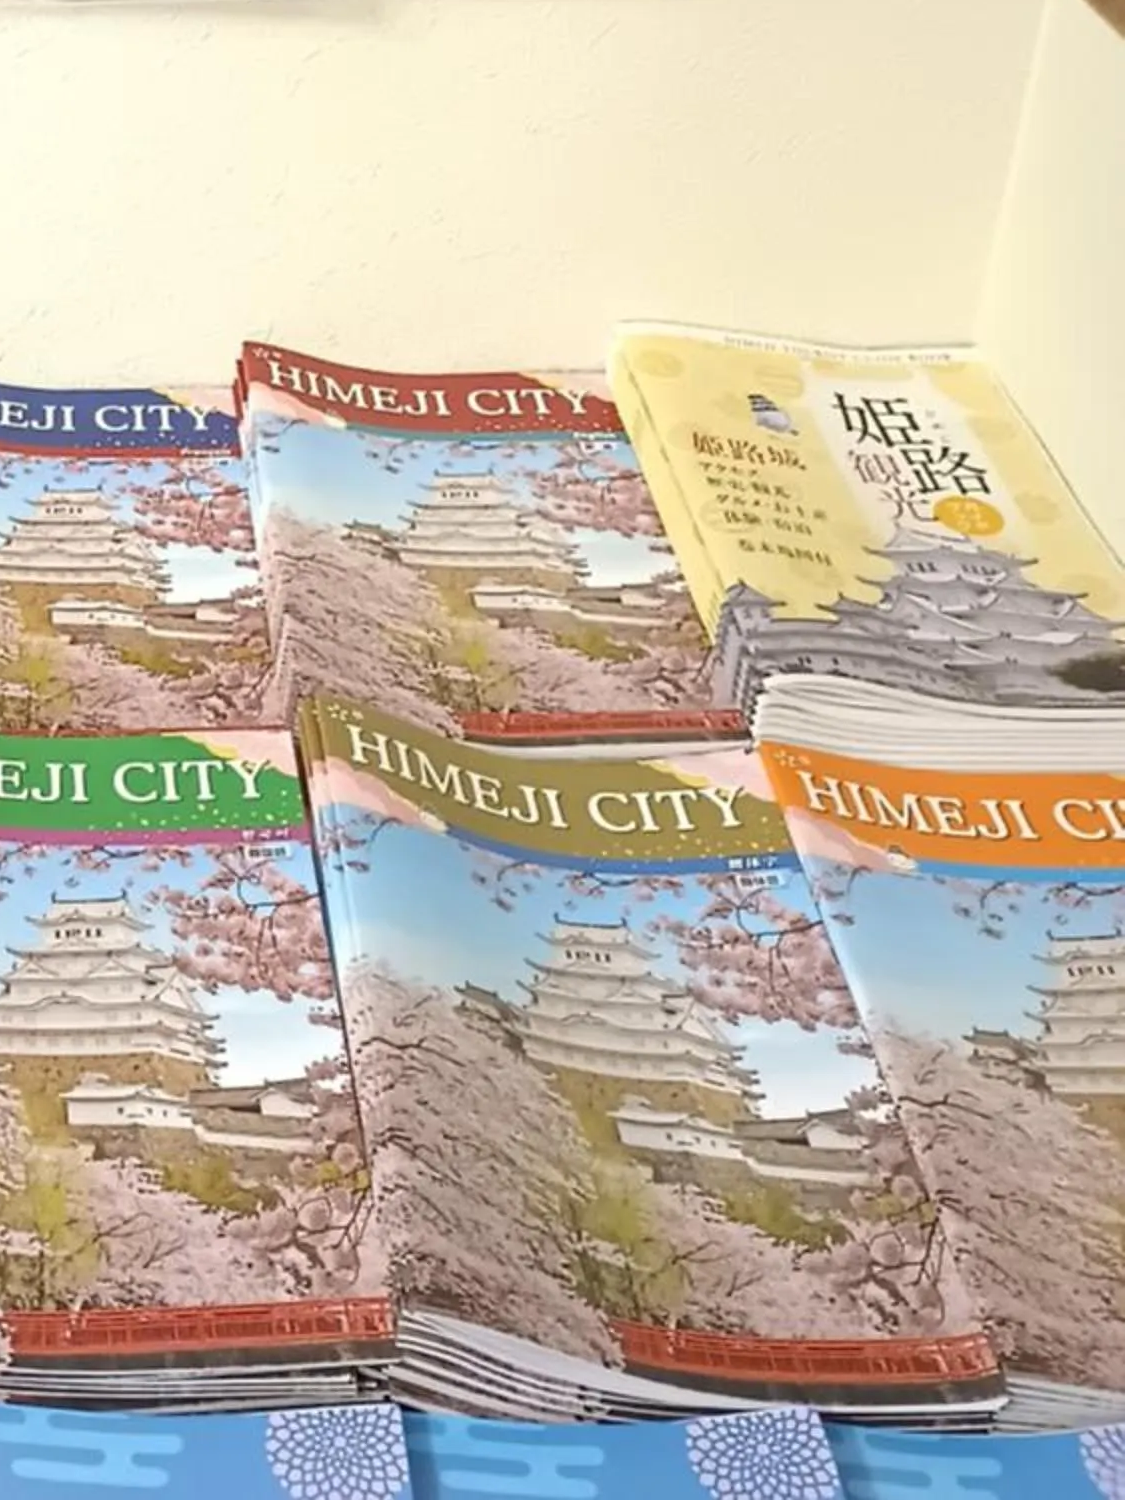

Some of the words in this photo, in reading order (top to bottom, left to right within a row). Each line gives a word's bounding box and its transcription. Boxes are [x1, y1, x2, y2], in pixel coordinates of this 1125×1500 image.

[94, 403, 219, 432] CITY
[268, 358, 452, 417] HIMEJI
[467, 386, 593, 417] CITY
[832, 391, 994, 497] 姫路
[848, 447, 939, 523] 観光
[112, 758, 272, 803] CITY
[346, 723, 572, 831] HIMEJI
[587, 785, 748, 835] CITY
[795, 768, 1043, 842] HIMEJI
